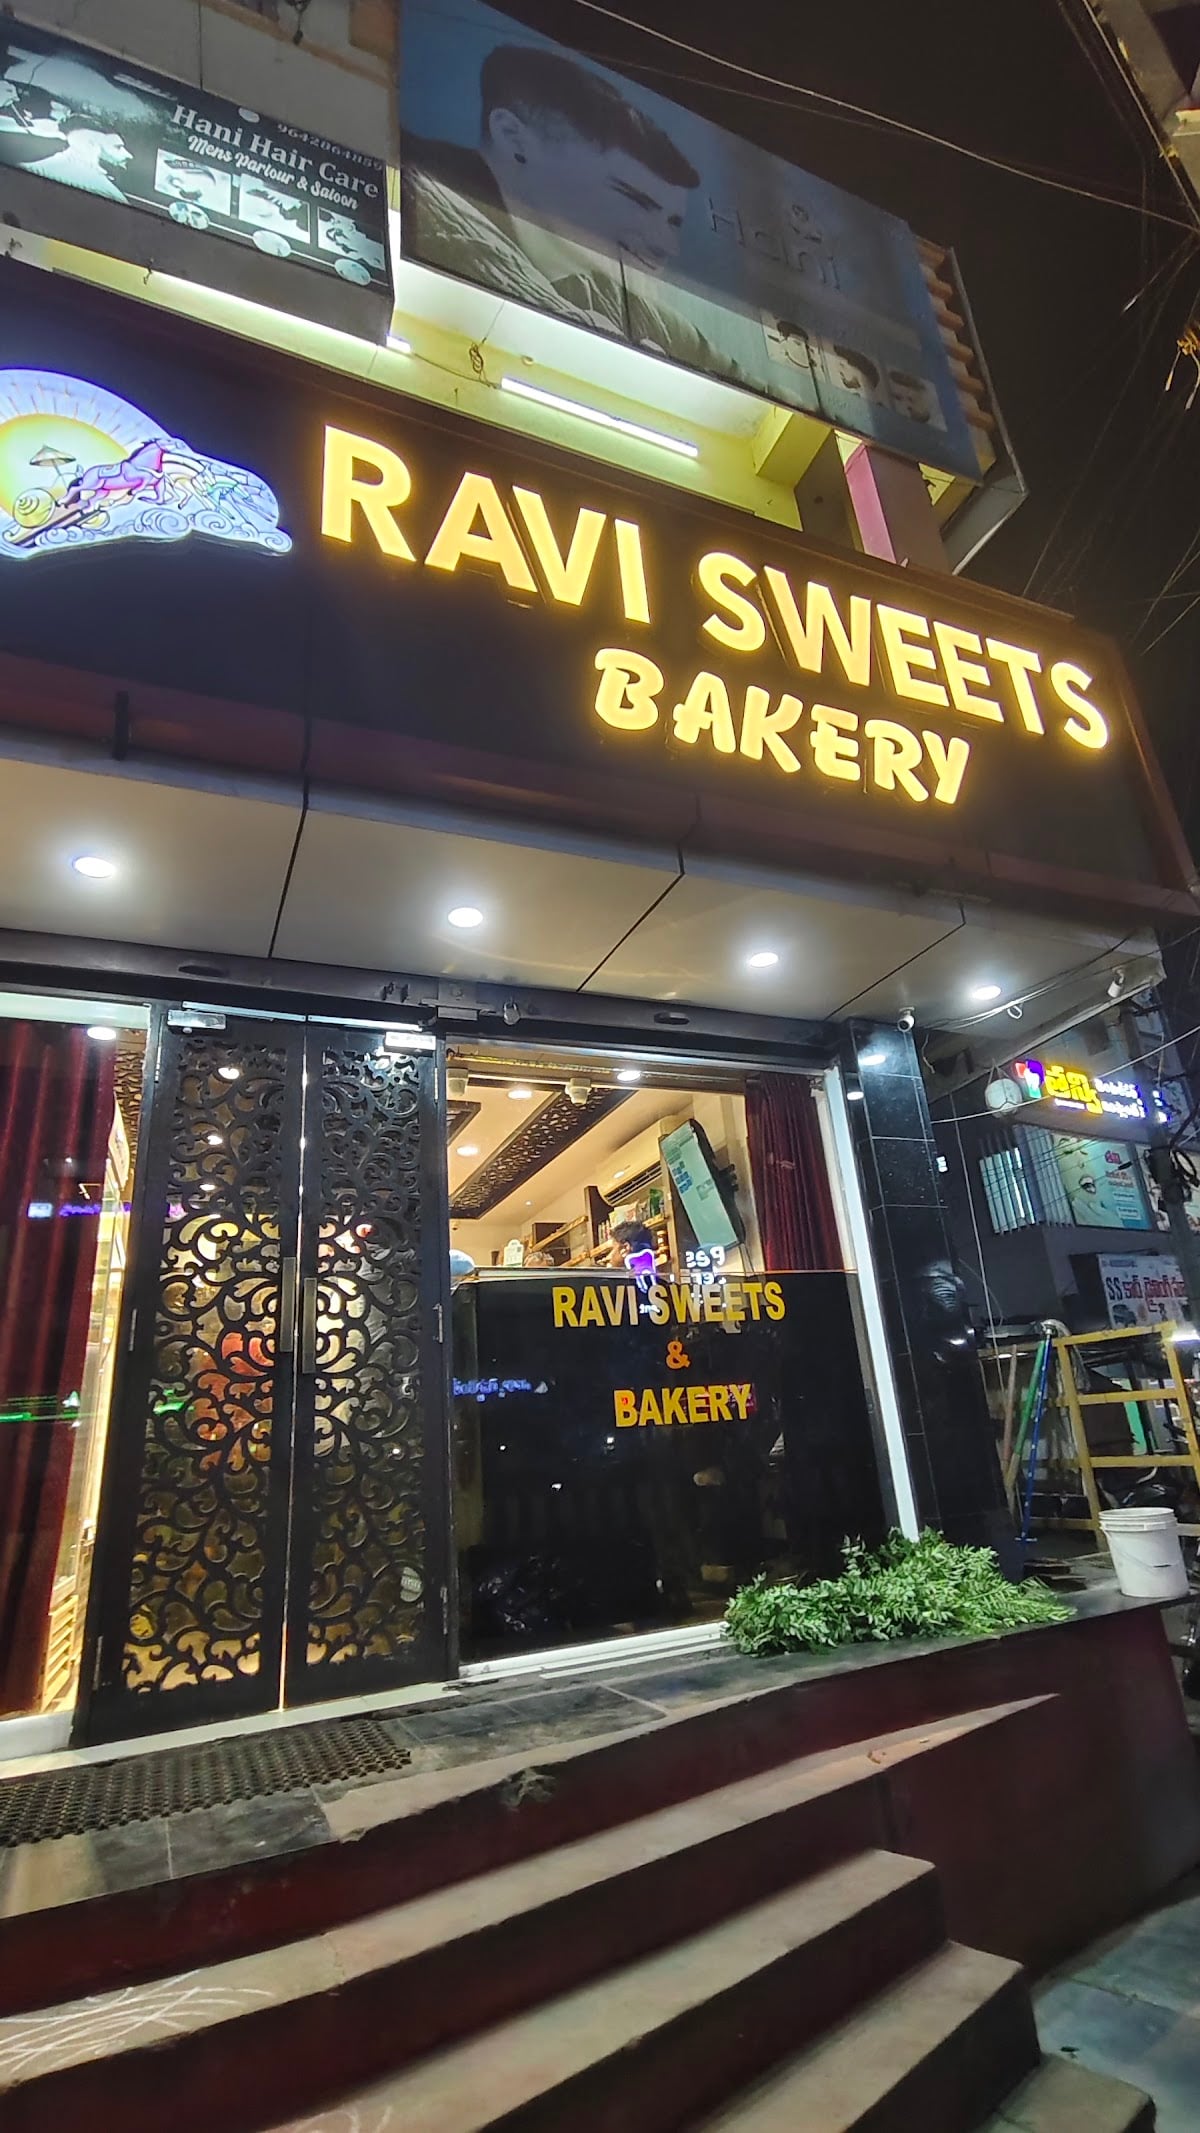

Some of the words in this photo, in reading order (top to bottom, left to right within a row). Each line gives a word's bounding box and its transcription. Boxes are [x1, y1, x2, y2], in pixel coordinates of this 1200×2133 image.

[171, 105, 243, 147] Hani
[250, 134, 313, 172] Hair
[319, 162, 379, 198] Care
[188, 135, 233, 162] Mens
[297, 175, 309, 191] &
[310, 180, 359, 210] Saloon
[321, 424, 652, 626] RAVI
[697, 551, 1110, 750] SWEETS
[594, 647, 972, 806] BAKERY
[552, 1284, 639, 1328] RAVI
[649, 1281, 786, 1326] SWEETS
[1106, 1277, 1123, 1301] SS
[666, 1341, 690, 1370] &
[614, 1382, 752, 1428] BAKERY
